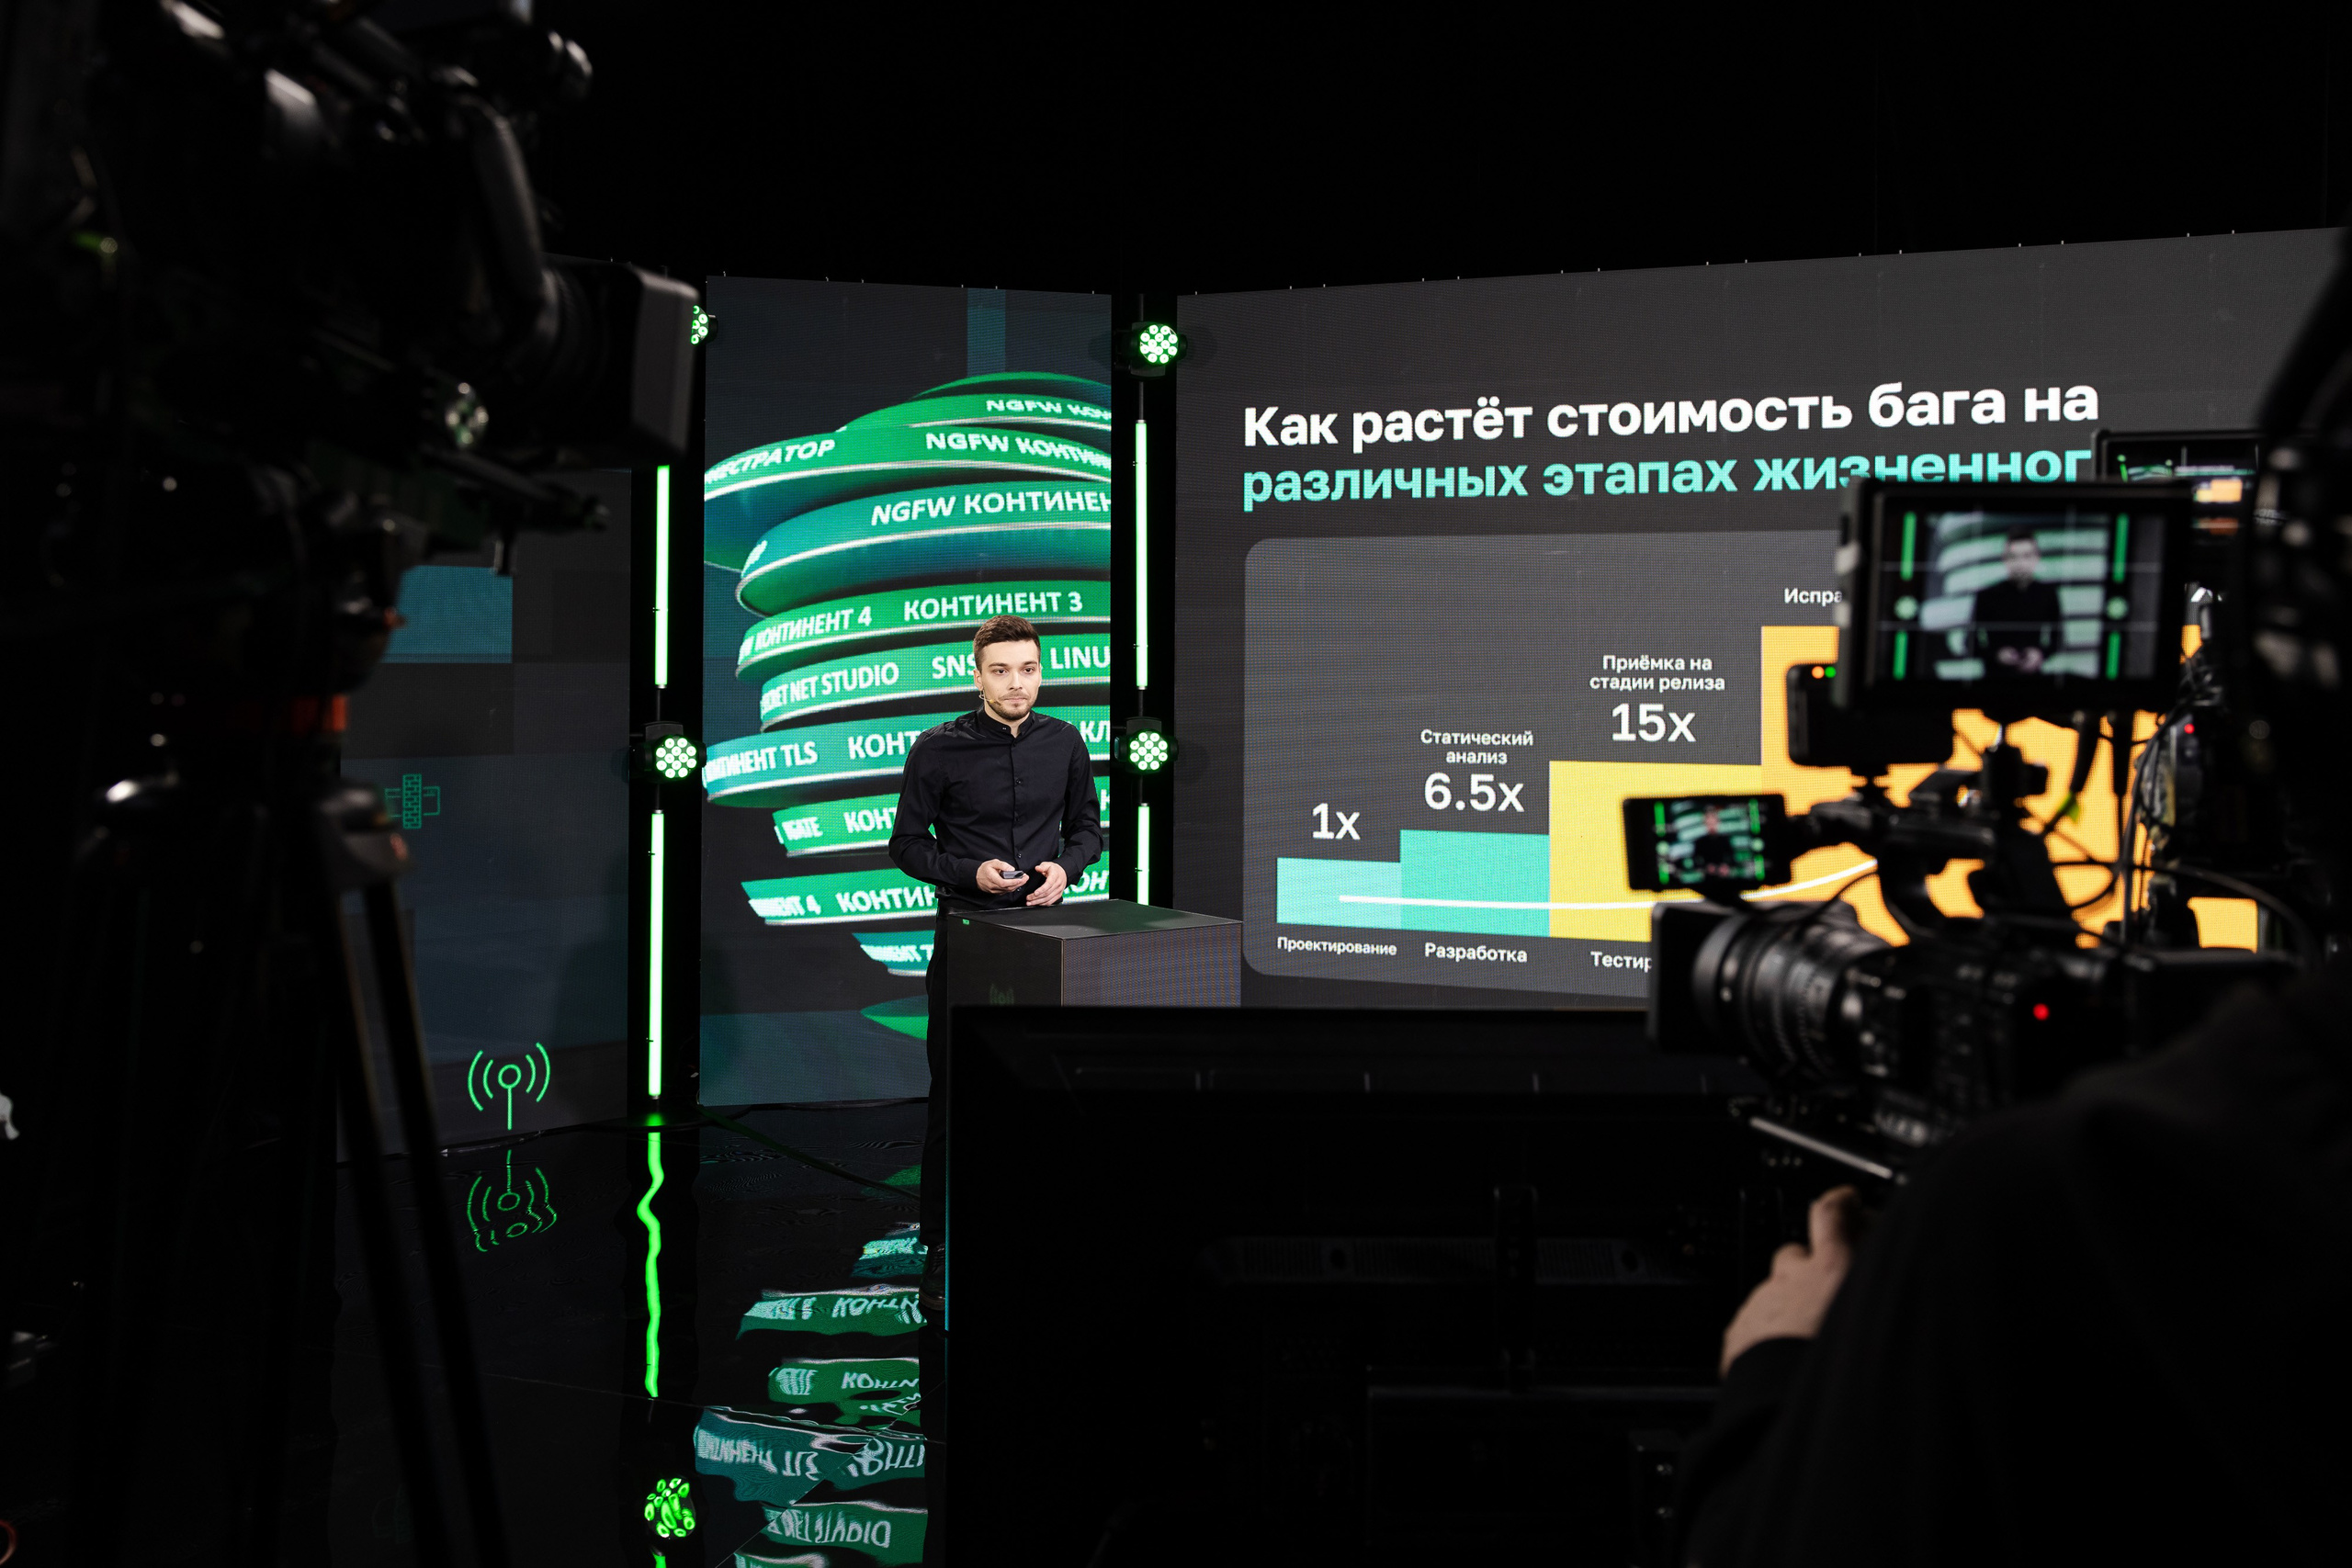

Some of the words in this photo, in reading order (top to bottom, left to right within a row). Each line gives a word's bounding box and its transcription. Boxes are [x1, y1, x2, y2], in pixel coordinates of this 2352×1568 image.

[986, 399, 1062, 414] NGFW
[1245, 406, 1339, 446] Как
[1352, 396, 1533, 454] растёт
[1547, 395, 1853, 438] стоимость
[1868, 381, 2007, 428] бага
[2024, 385, 2098, 423] на
[925, 432, 1009, 453] NGFW
[1243, 465, 1529, 513] различных
[1543, 459, 1738, 496] этапах
[871, 496, 956, 526] NGFW
[857, 605, 872, 627] 4
[904, 592, 1062, 622] КОНТИНЕНТ
[1068, 591, 1083, 613] 3
[1602, 654, 1685, 673] Приёмка
[1690, 658, 1713, 671] на
[789, 675, 820, 700] NET
[821, 661, 899, 696] STUDIO
[1589, 677, 1655, 692] стадии
[1659, 678, 1725, 693] релиза
[1420, 728, 1533, 747] Статический
[781, 741, 819, 768] TLS
[1446, 750, 1508, 765] анализ
[1277, 936, 1397, 956] Проектирование
[1424, 942, 1528, 964] Разработка
[1590, 951, 1652, 972] Тестир
